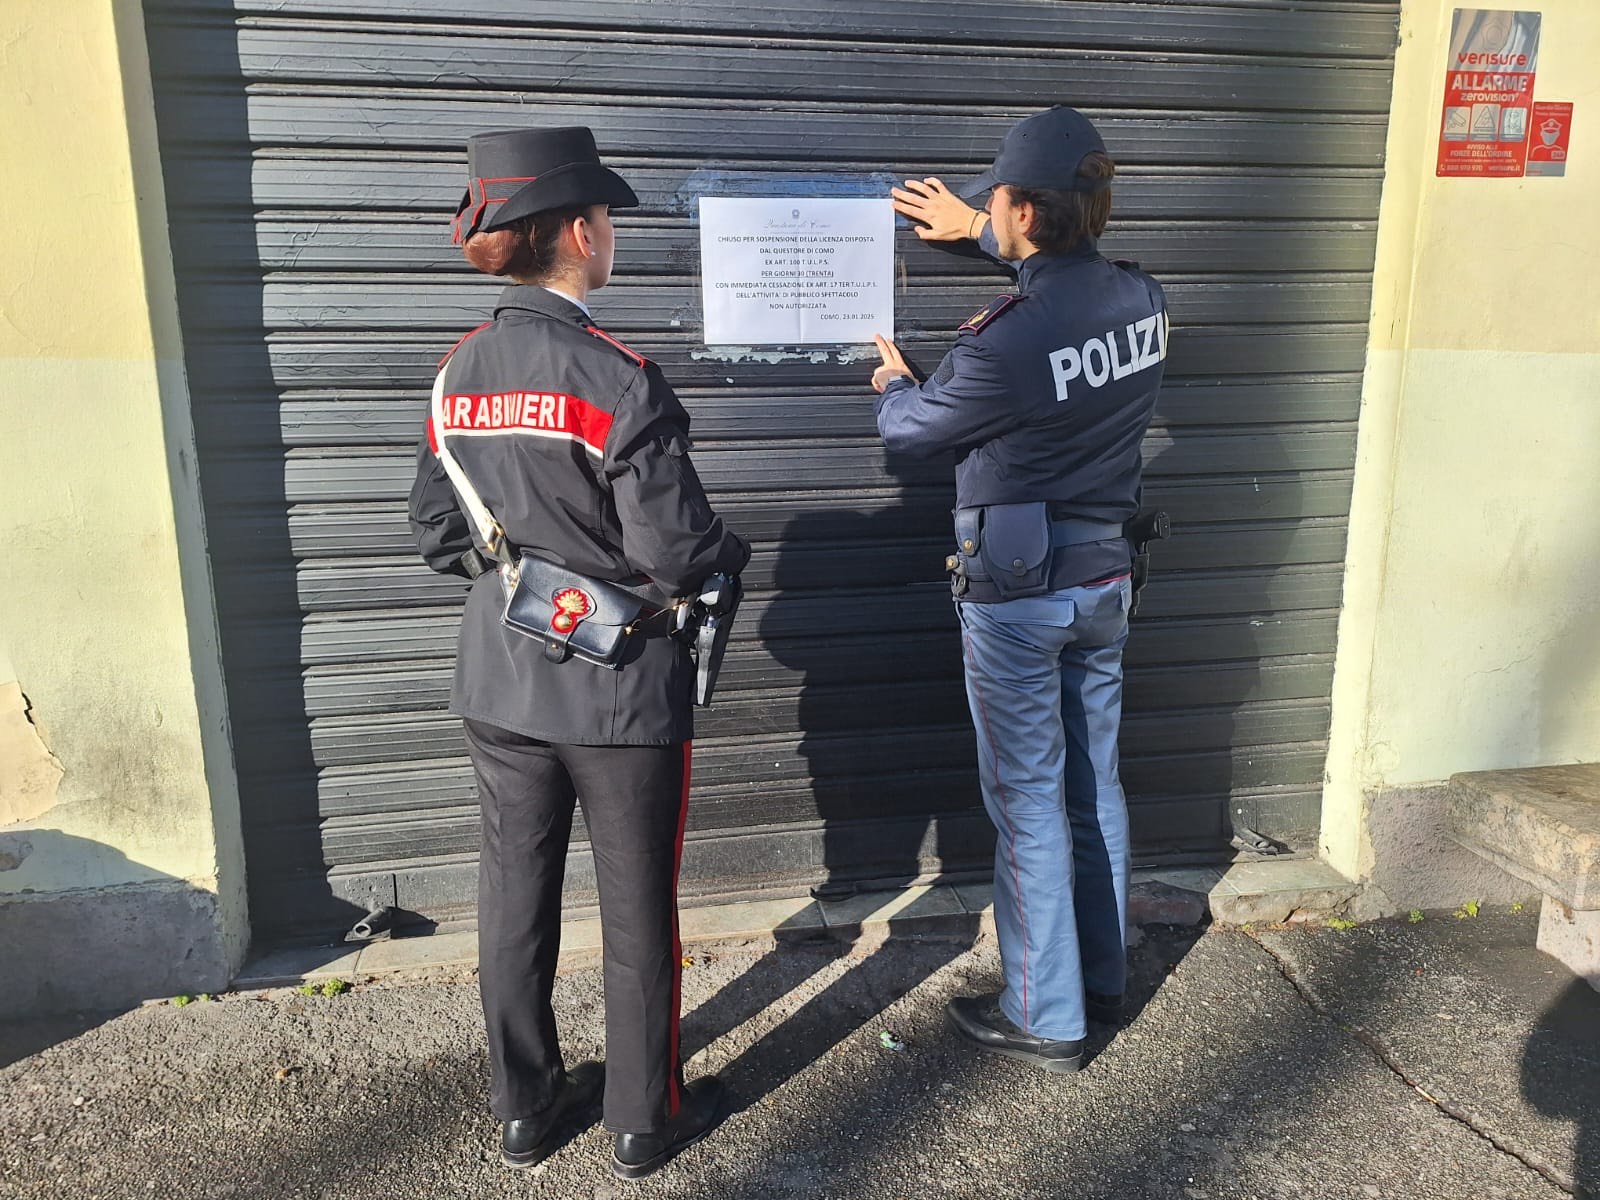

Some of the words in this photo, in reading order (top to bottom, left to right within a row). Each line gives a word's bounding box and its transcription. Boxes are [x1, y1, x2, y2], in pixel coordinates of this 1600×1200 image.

[1458, 52, 1527, 65] verisure
[1451, 73, 1529, 92] ALLARME
[1460, 92, 1519, 102] zerovision
[805, 270, 834, 278] (TRENTA)
[1048, 309, 1169, 402] POLIZI
[442, 393, 566, 429] ARABINIERI
